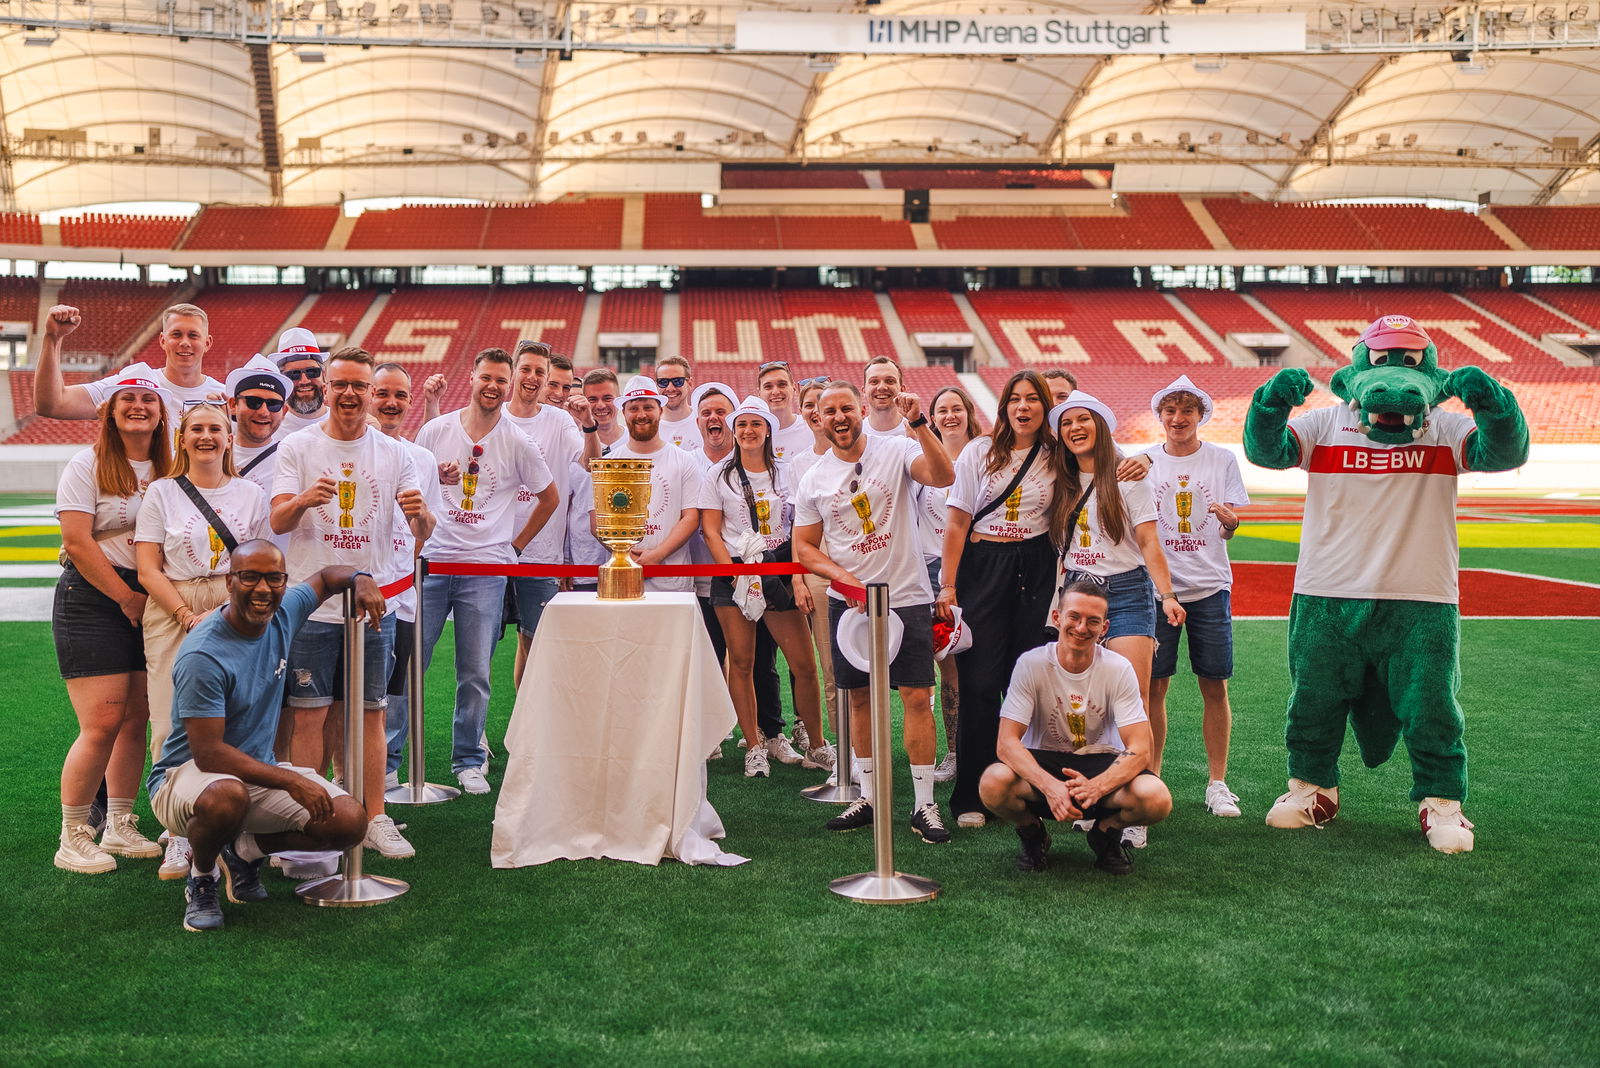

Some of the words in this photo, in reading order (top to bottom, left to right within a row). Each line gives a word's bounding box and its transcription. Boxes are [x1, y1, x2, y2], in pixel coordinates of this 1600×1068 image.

[1044, 19, 1170, 50] Stuttgart
[448, 510, 485, 520] DFB-POKAL
[455, 516, 478, 525] SIEGER
[989, 525, 1033, 534] DFB-POKAL
[324, 534, 371, 543] DFB-POKAL
[332, 542, 361, 550] SIEGER
[862, 542, 888, 555] SIEGER
